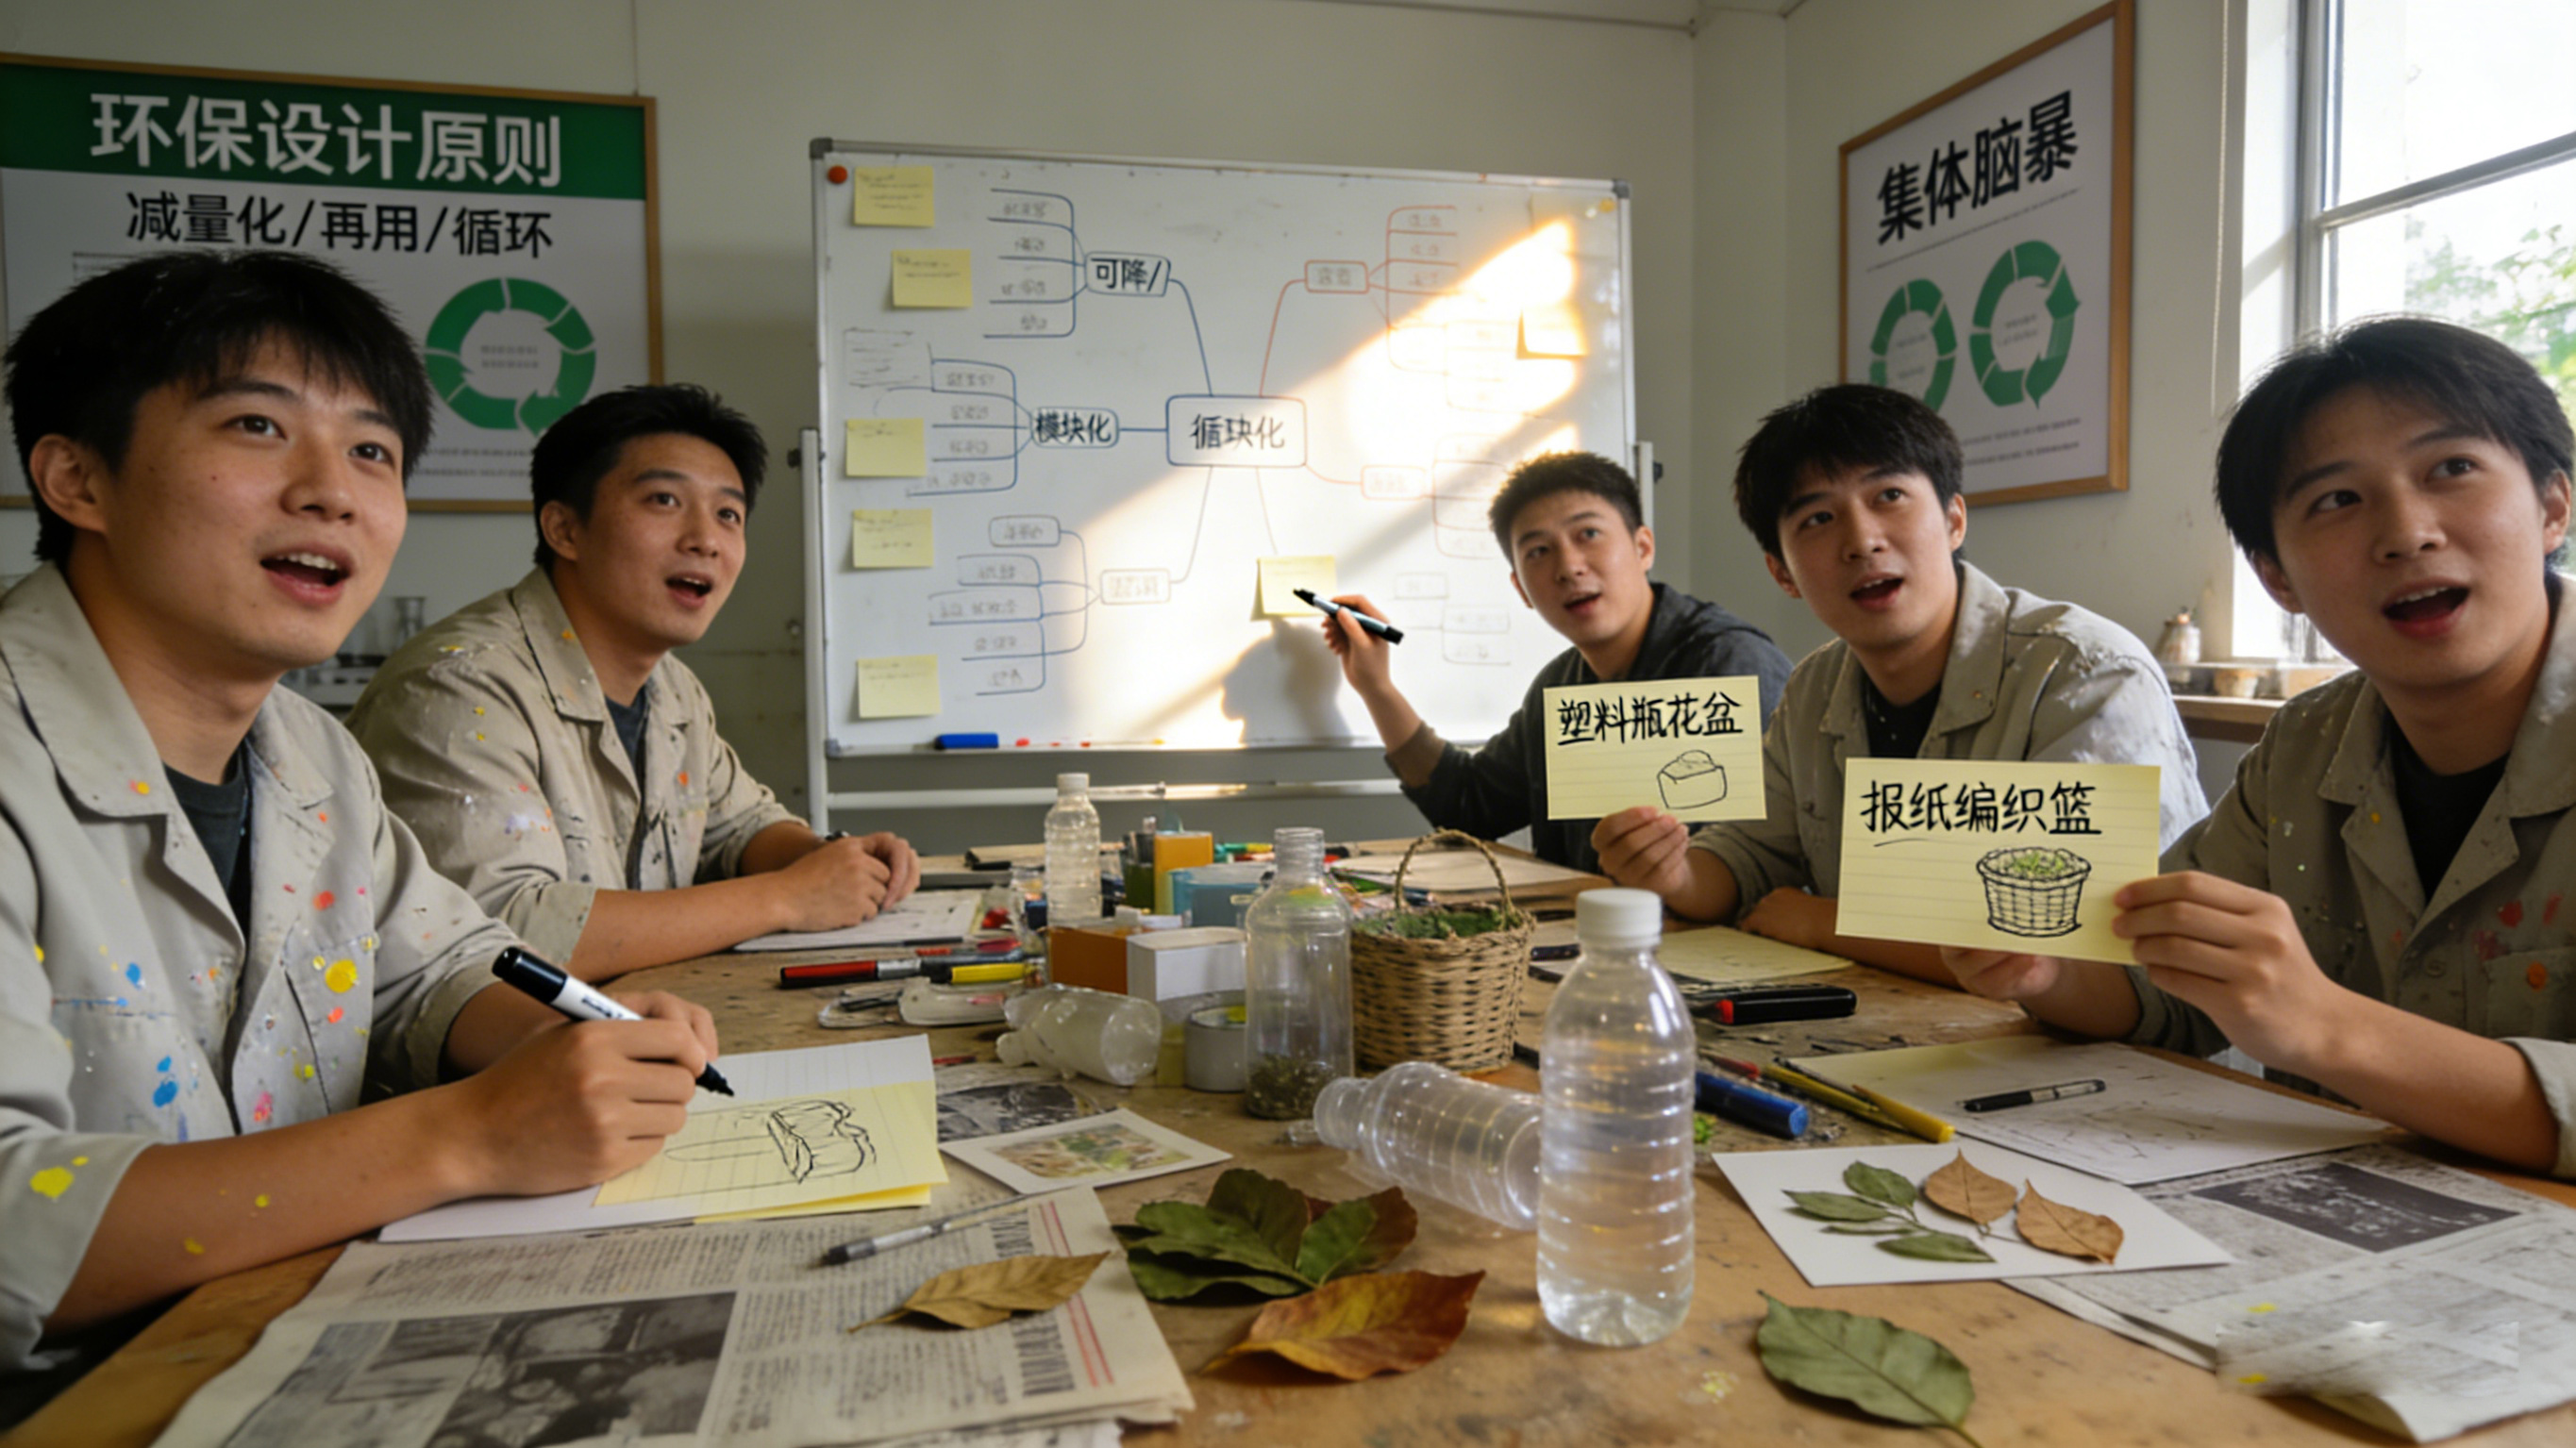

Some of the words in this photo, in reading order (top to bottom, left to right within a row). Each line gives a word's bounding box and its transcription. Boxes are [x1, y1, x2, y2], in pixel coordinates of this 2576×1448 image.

[90, 92, 561, 187] 环保设计原则
[1877, 90, 2078, 245] 集体脑暴
[125, 191, 554, 258] 减量化/再用/循环
[1557, 691, 1744, 745] 塑料瓶花盆
[1860, 780, 2102, 835] 报纸编织篮
